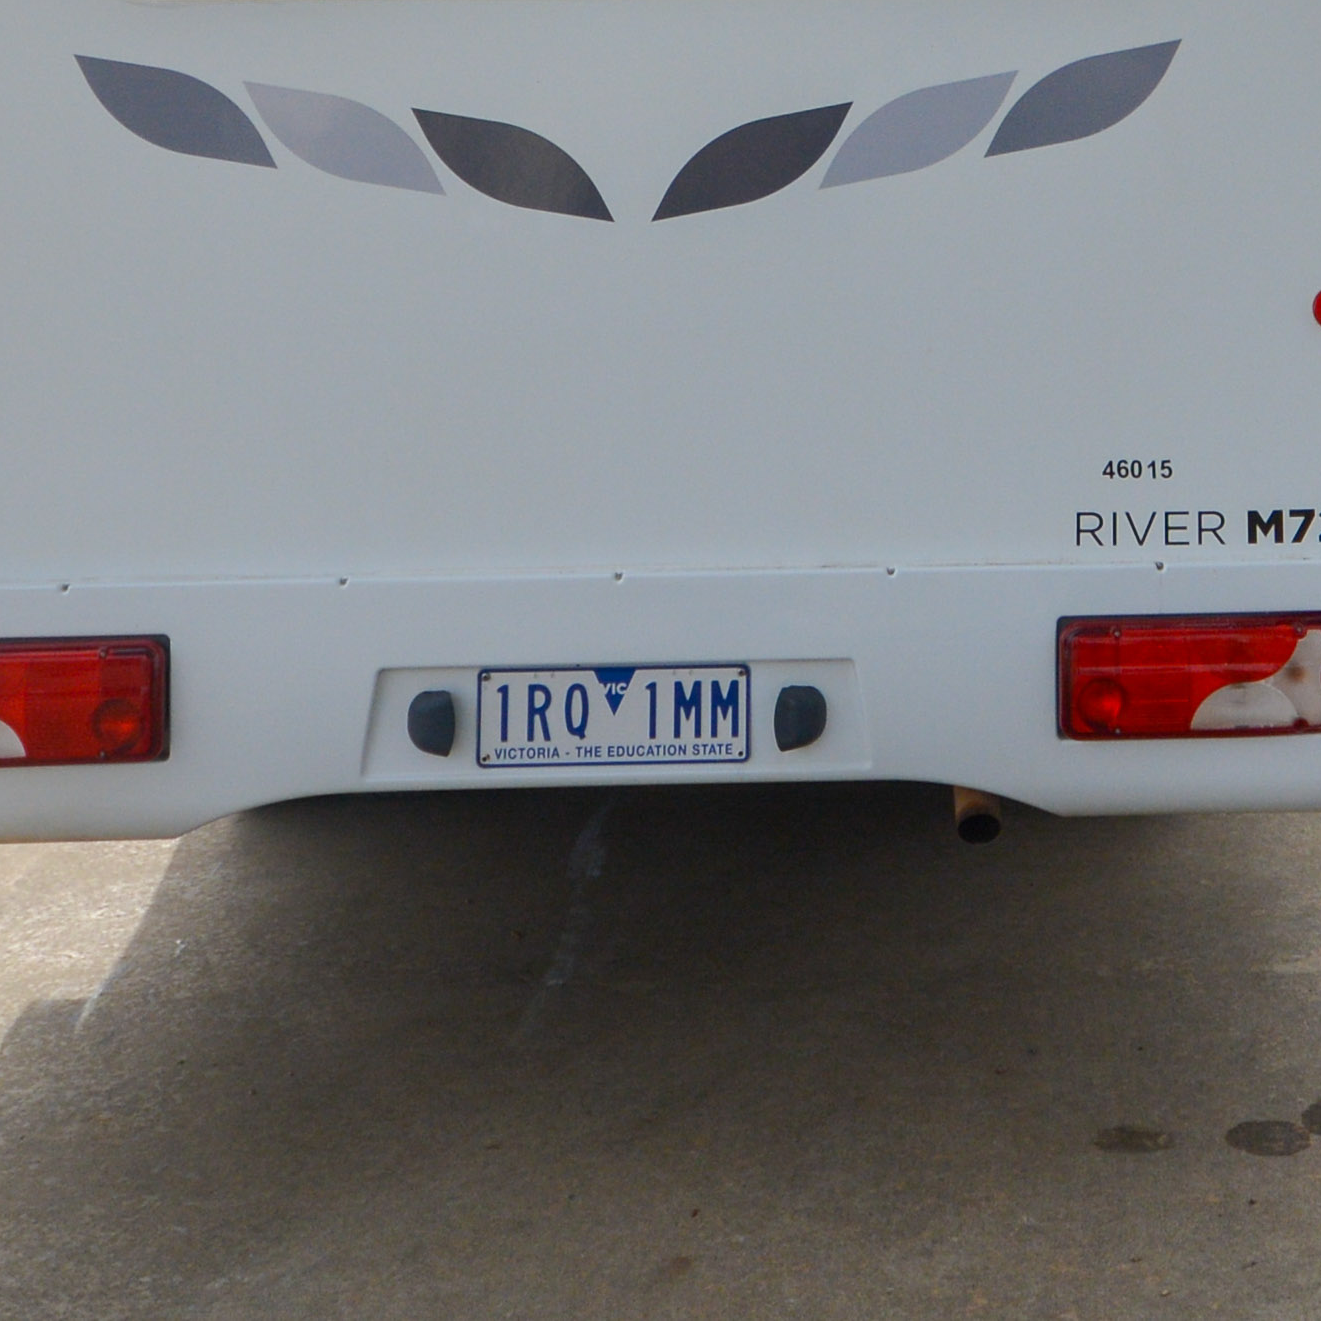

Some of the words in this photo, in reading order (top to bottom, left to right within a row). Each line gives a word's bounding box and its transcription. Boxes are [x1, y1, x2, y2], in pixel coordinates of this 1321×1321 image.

[1076, 511, 1226, 547] RIVER
[599, 682, 627, 695] VIC
[496, 683, 589, 743] 1RQ
[645, 679, 739, 740] 1MM
[494, 747, 560, 760] VICTORIA
[576, 746, 602, 758] THE
[607, 744, 687, 758] EDUCATION
[692, 743, 733, 756] STATE
